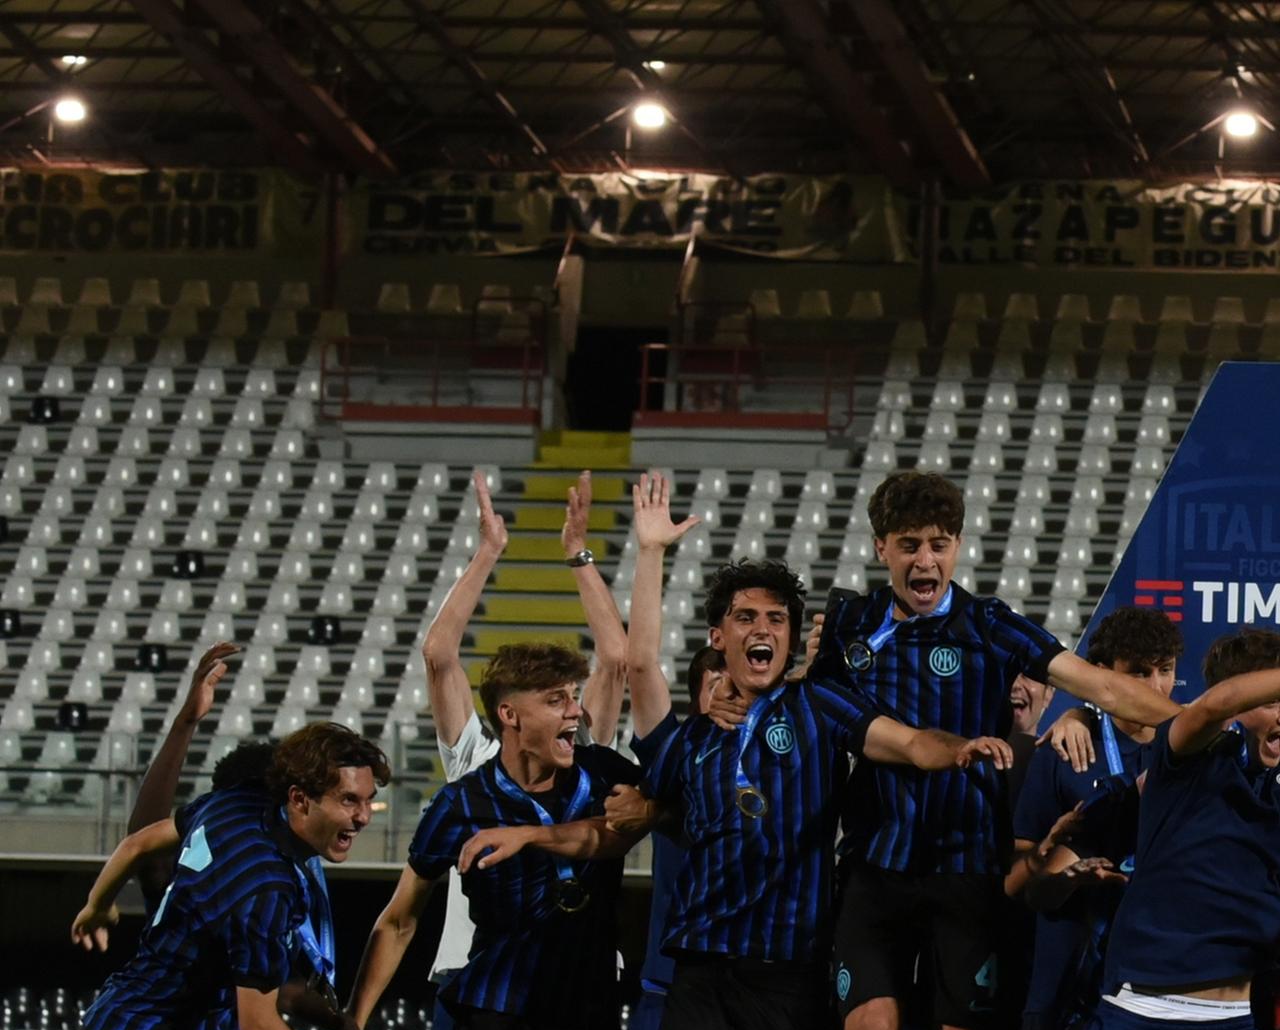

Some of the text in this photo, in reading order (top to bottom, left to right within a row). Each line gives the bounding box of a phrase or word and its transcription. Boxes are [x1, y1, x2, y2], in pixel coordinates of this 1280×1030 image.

[369, 195, 783, 237] DEL MARE
[1053, 246, 1135, 267] DEL
